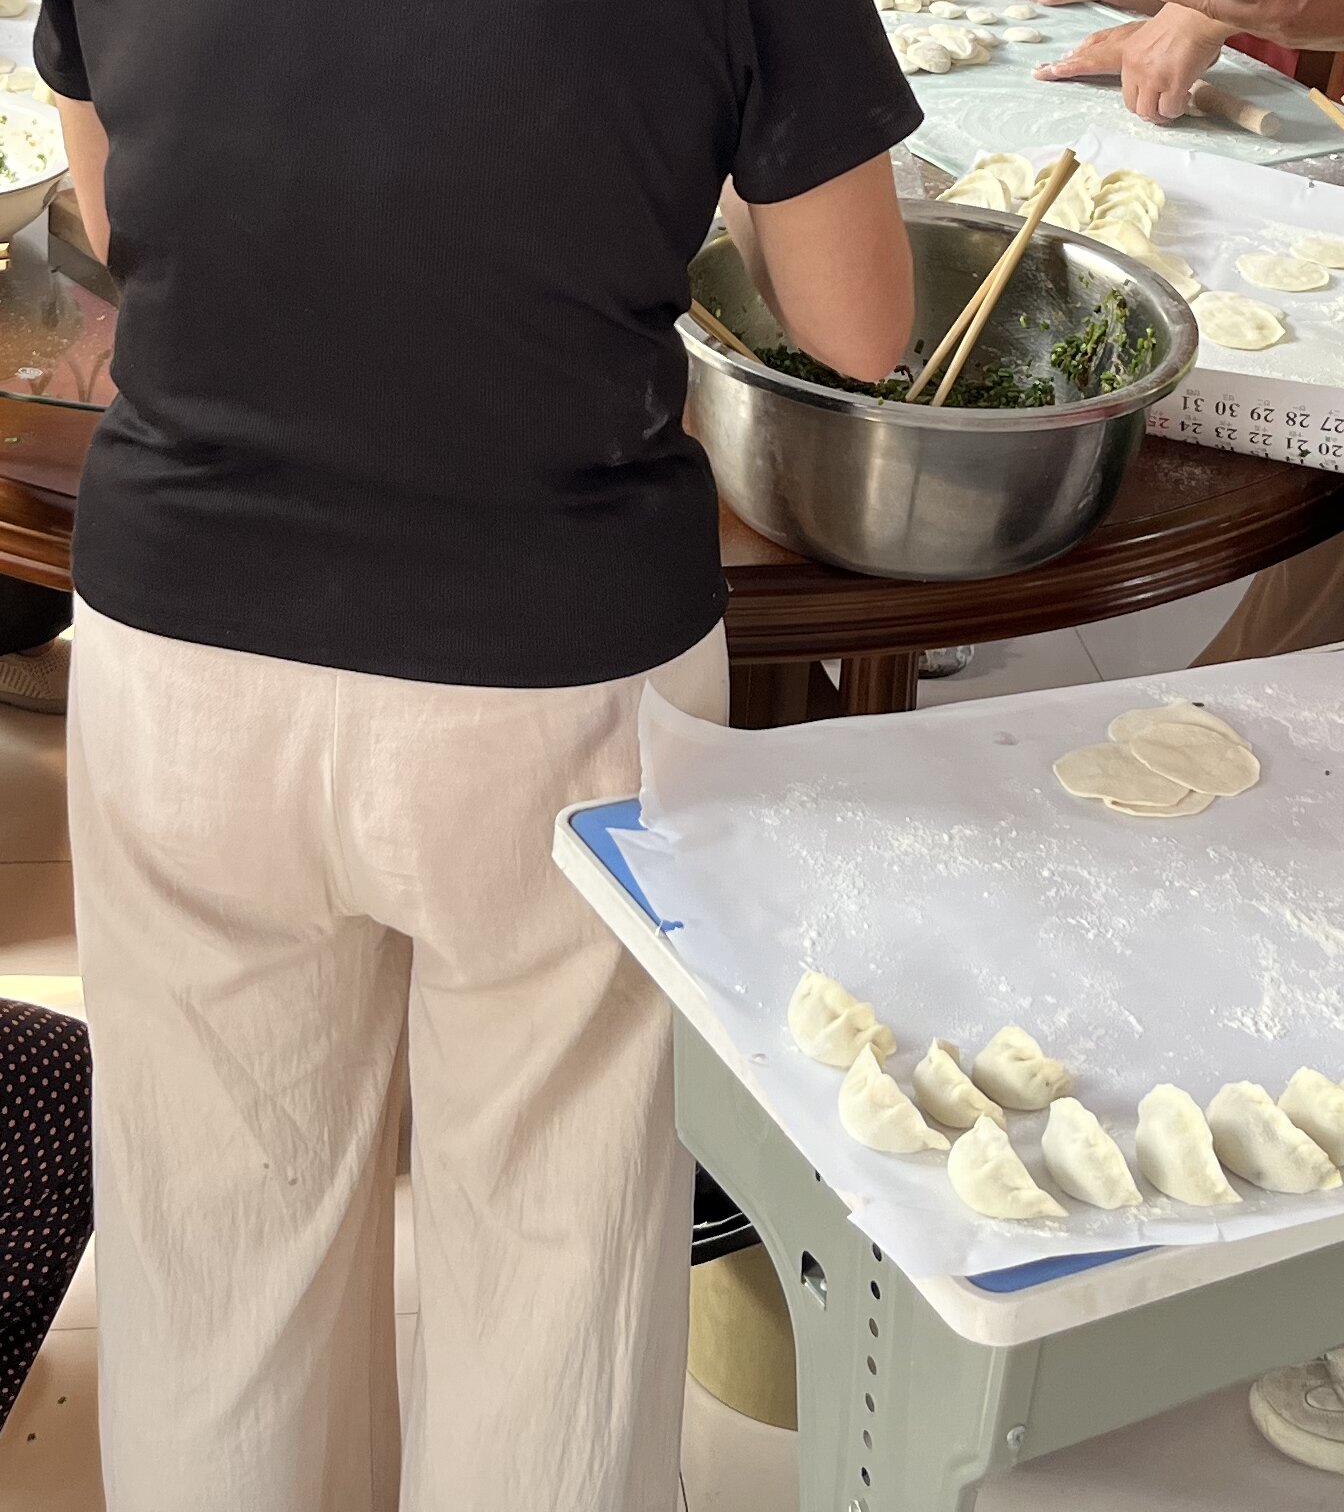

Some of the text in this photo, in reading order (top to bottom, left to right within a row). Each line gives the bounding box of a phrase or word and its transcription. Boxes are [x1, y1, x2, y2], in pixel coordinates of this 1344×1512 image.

[1182, 396, 1205, 412] 31
[1215, 400, 1240, 417] 30
[1148, 415, 1170, 429] 25
[1250, 406, 1275, 423] 29
[1285, 411, 1310, 428] 28
[1180, 420, 1202, 434] 24
[1215, 426, 1238, 440] 23
[1249, 431, 1273, 446] 22
[1286, 437, 1309, 456] 21
[1318, 443, 1343, 457] 20
